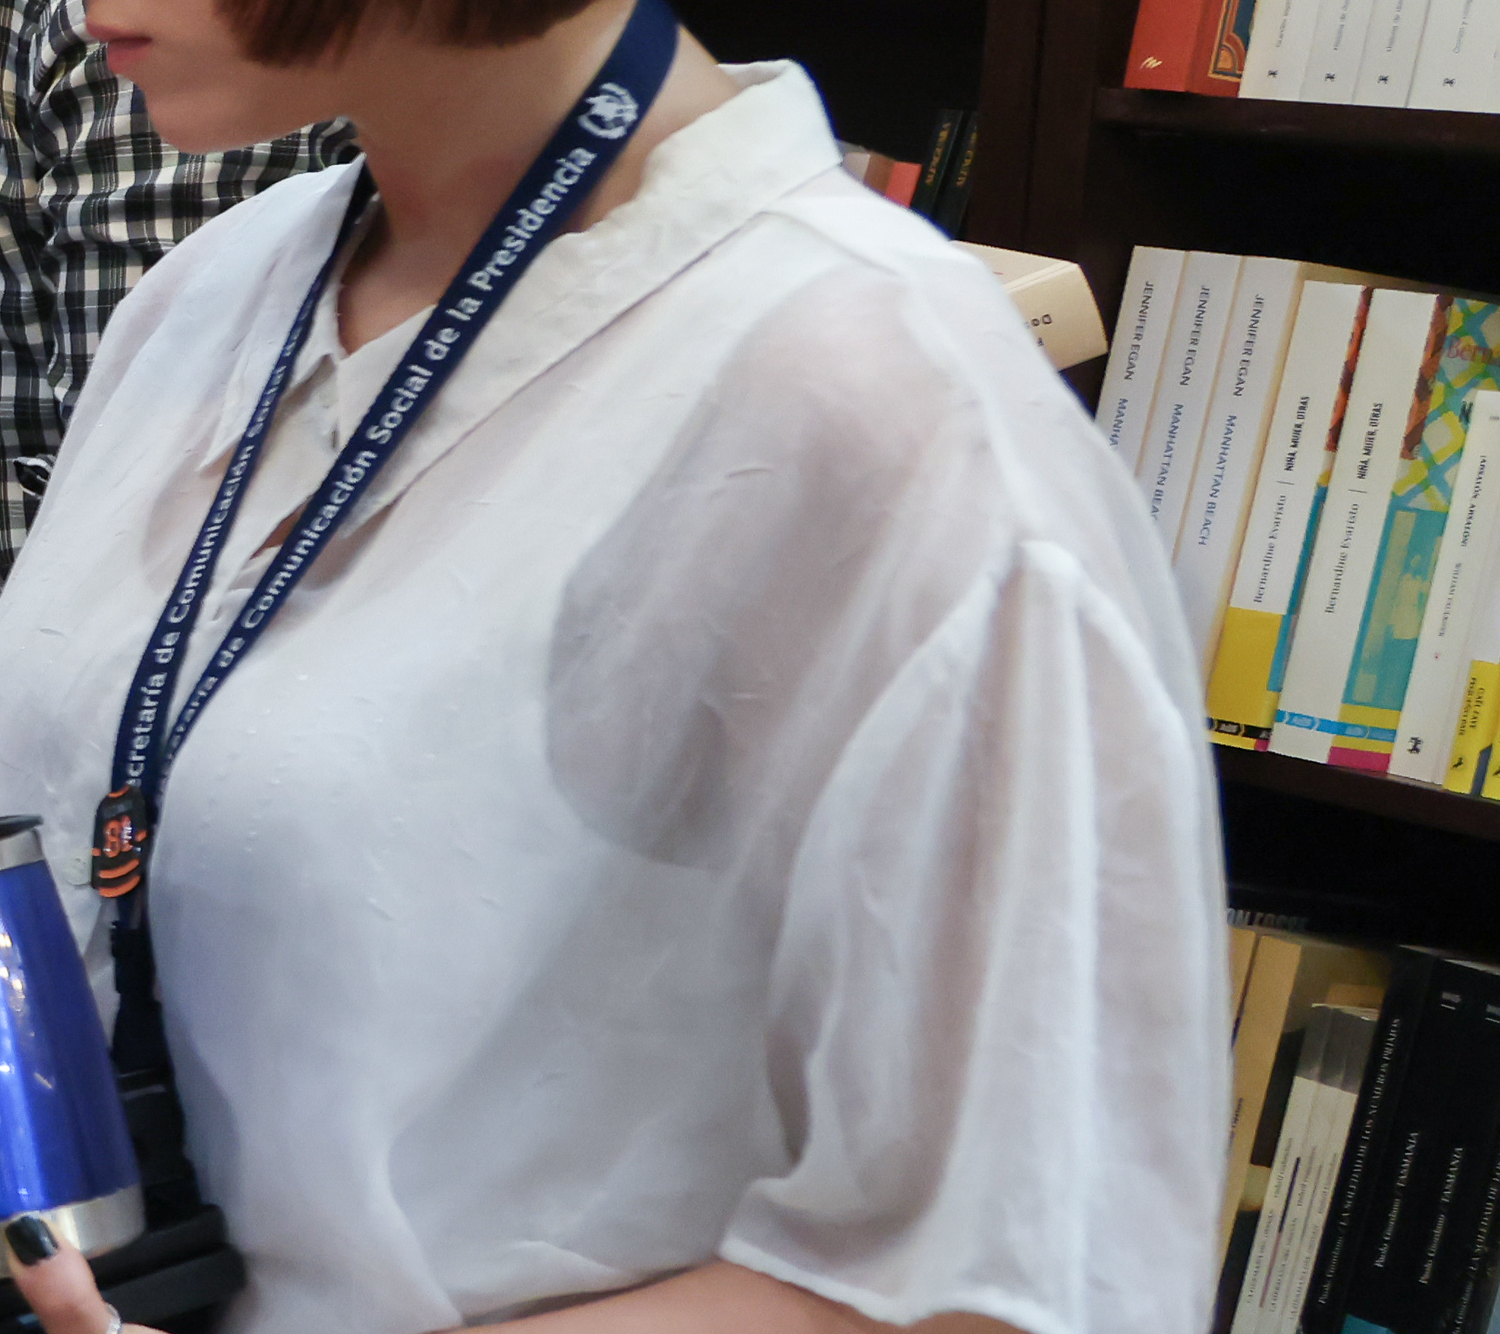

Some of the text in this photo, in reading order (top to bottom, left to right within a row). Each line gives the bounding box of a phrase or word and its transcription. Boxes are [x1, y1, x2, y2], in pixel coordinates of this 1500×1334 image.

[241, 145, 597, 631] Comunicación Social de la Presidencia
[1124, 280, 1155, 381] JENNIFER EGAN
[1198, 294, 1266, 546] JENNIFER EGAN MANHATTAN BEACH
[169, 442, 255, 626] Comunicación
[1253, 544, 1276, 603] Bernardine
